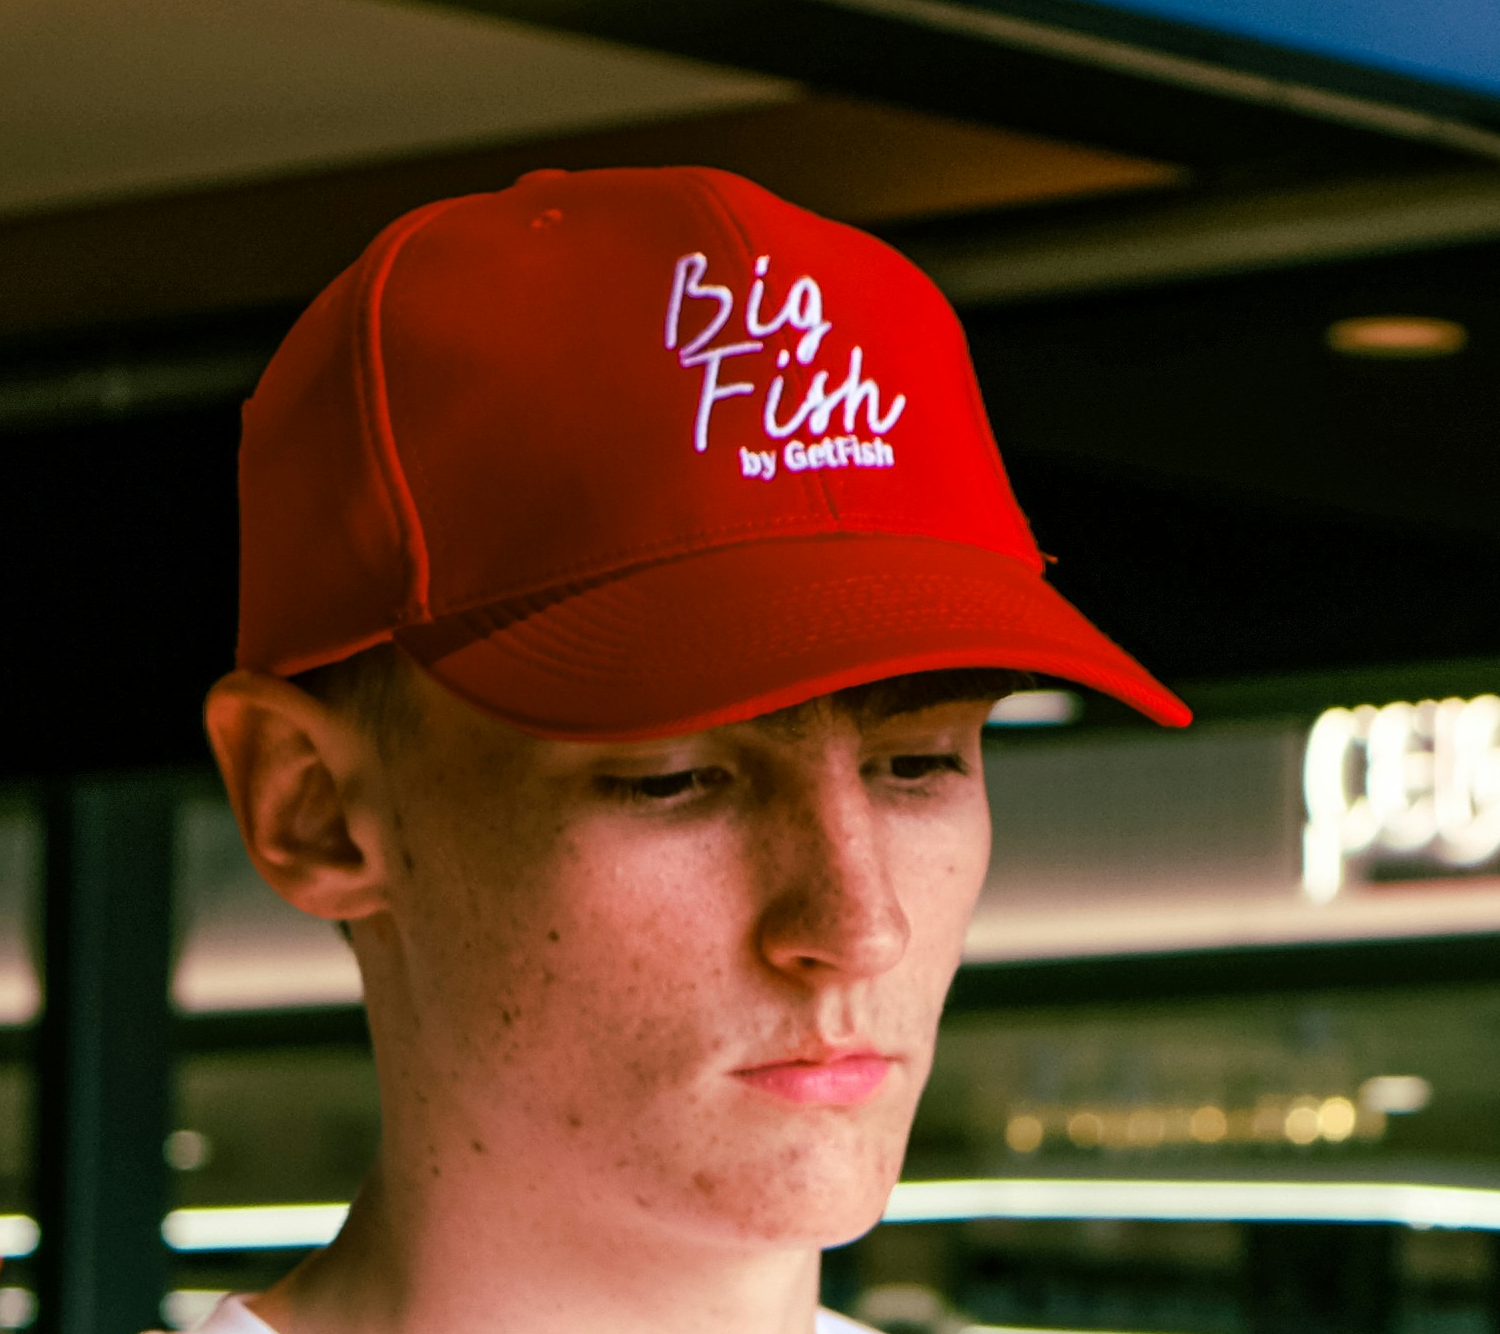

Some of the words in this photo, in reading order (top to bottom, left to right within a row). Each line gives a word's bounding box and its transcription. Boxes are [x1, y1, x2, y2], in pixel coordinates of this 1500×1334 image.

[665, 252, 832, 365] Big
[679, 341, 906, 453] Fish
[739, 446, 776, 480] by
[784, 434, 895, 471] GetFish
